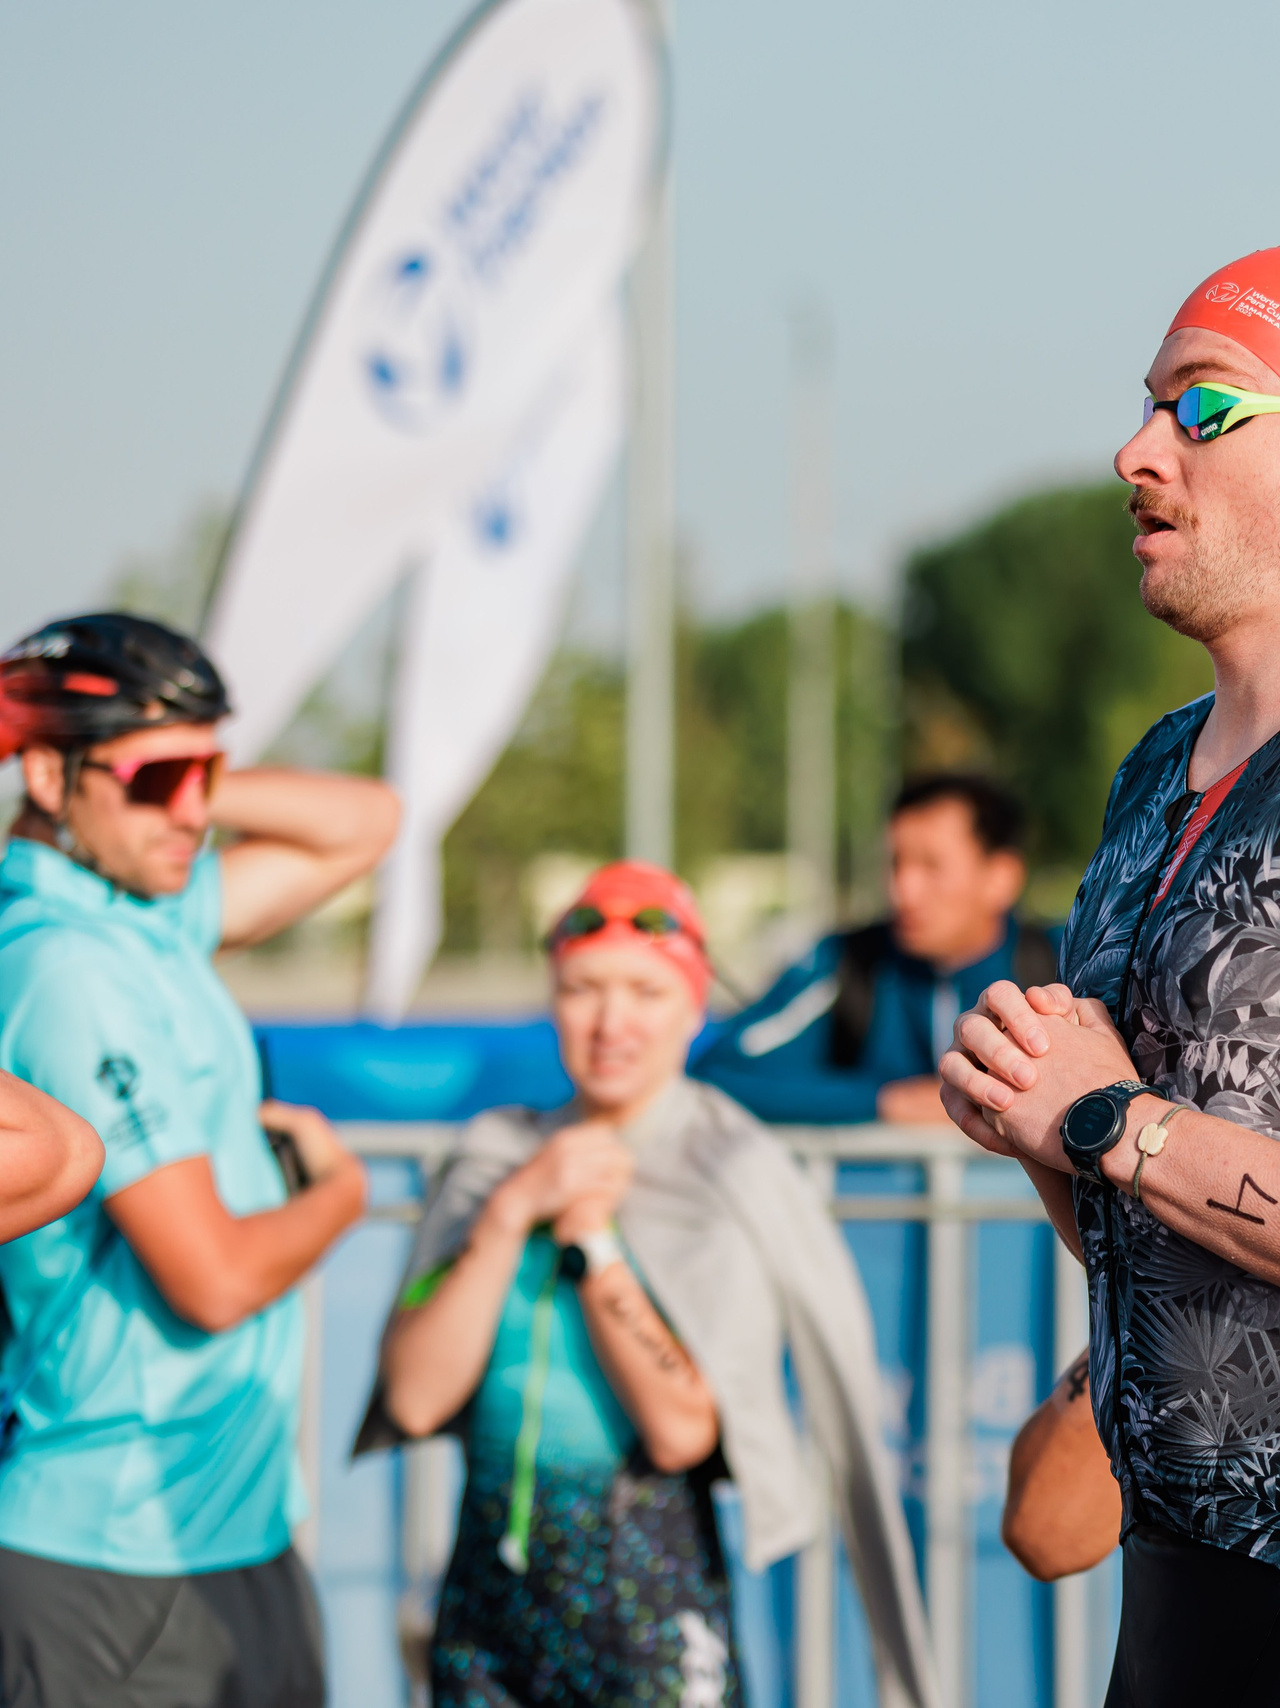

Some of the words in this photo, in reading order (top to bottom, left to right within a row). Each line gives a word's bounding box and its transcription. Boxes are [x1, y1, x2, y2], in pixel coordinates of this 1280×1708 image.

[1245, 295, 1266, 310] Para
[1252, 291, 1280, 309] World
[1235, 307, 1253, 317] 2025
